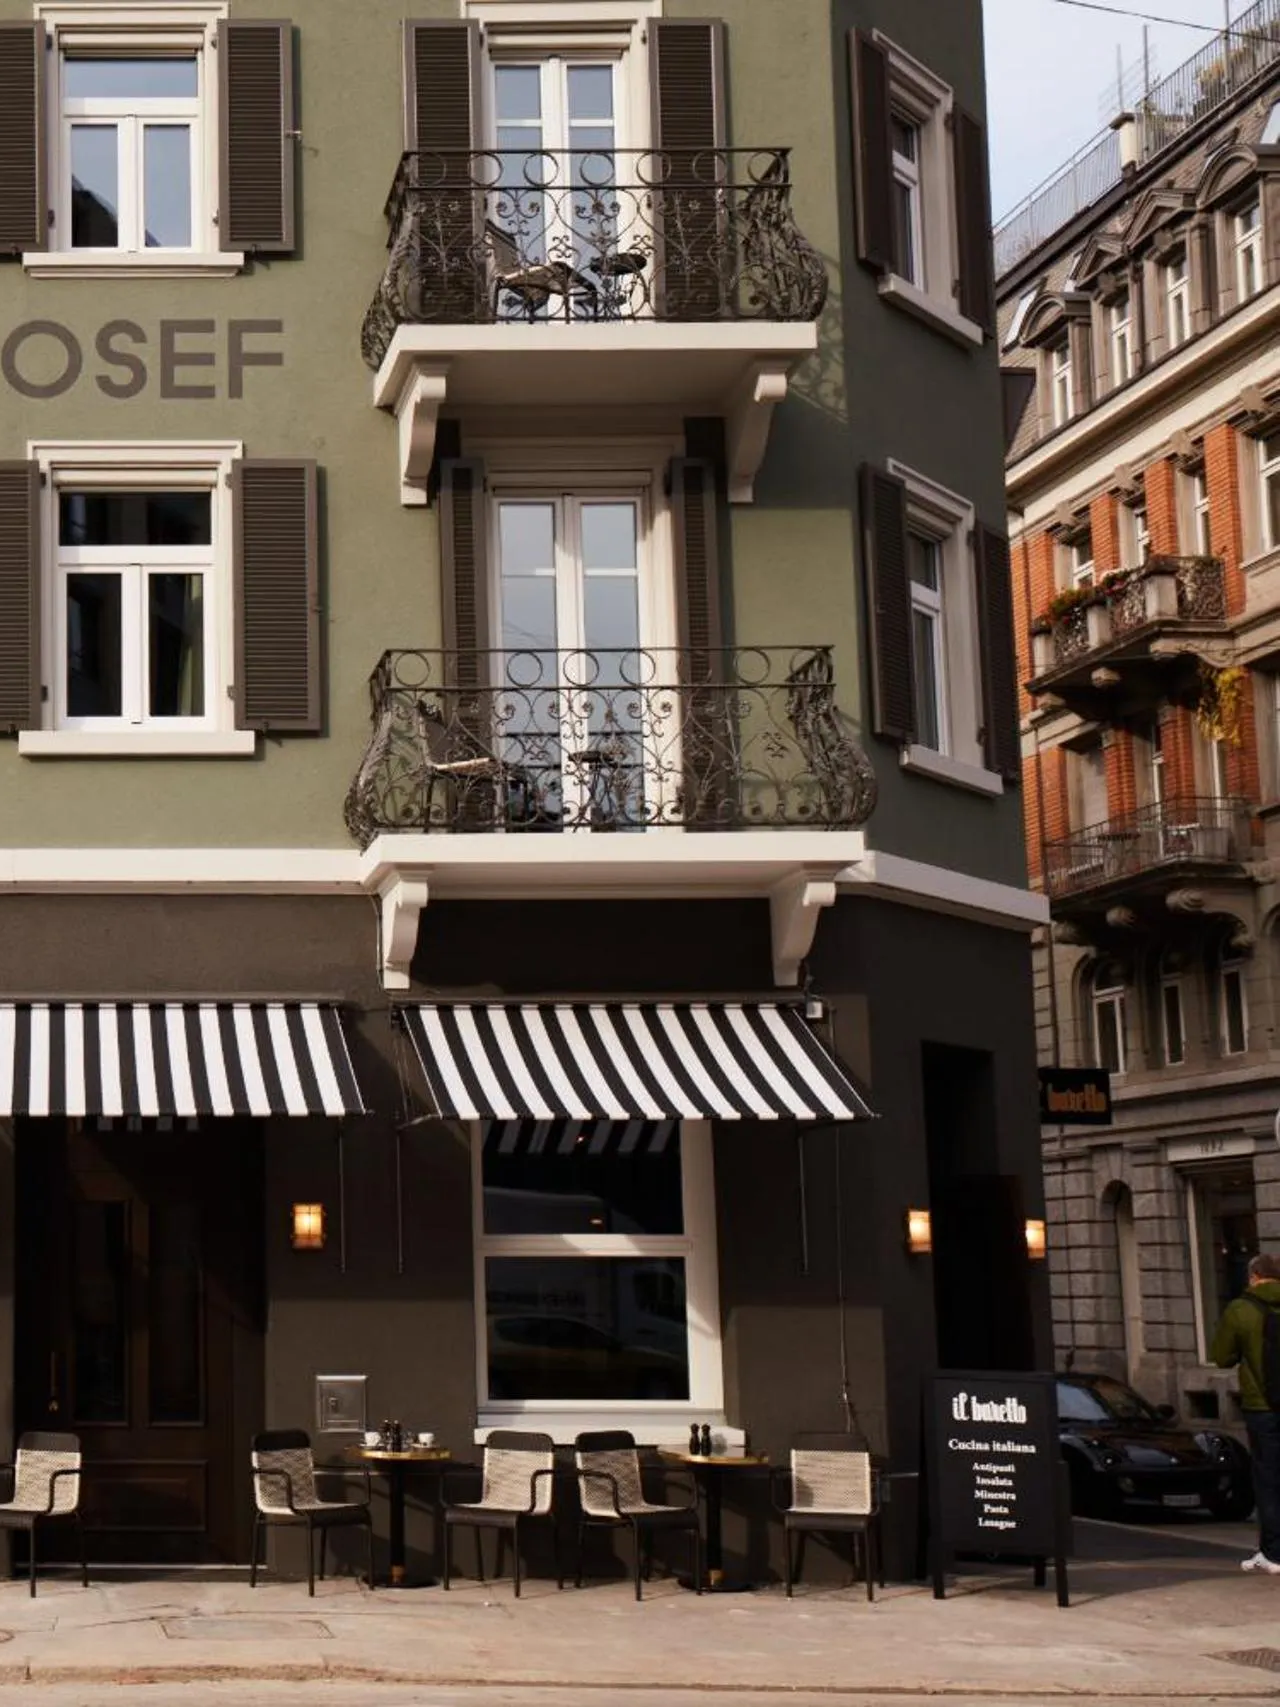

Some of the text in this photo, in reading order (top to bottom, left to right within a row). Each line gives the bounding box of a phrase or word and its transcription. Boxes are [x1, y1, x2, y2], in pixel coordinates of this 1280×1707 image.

[948, 1438, 1036, 1454] Cucina italiana
[983, 1504, 1009, 1513] Pasta
